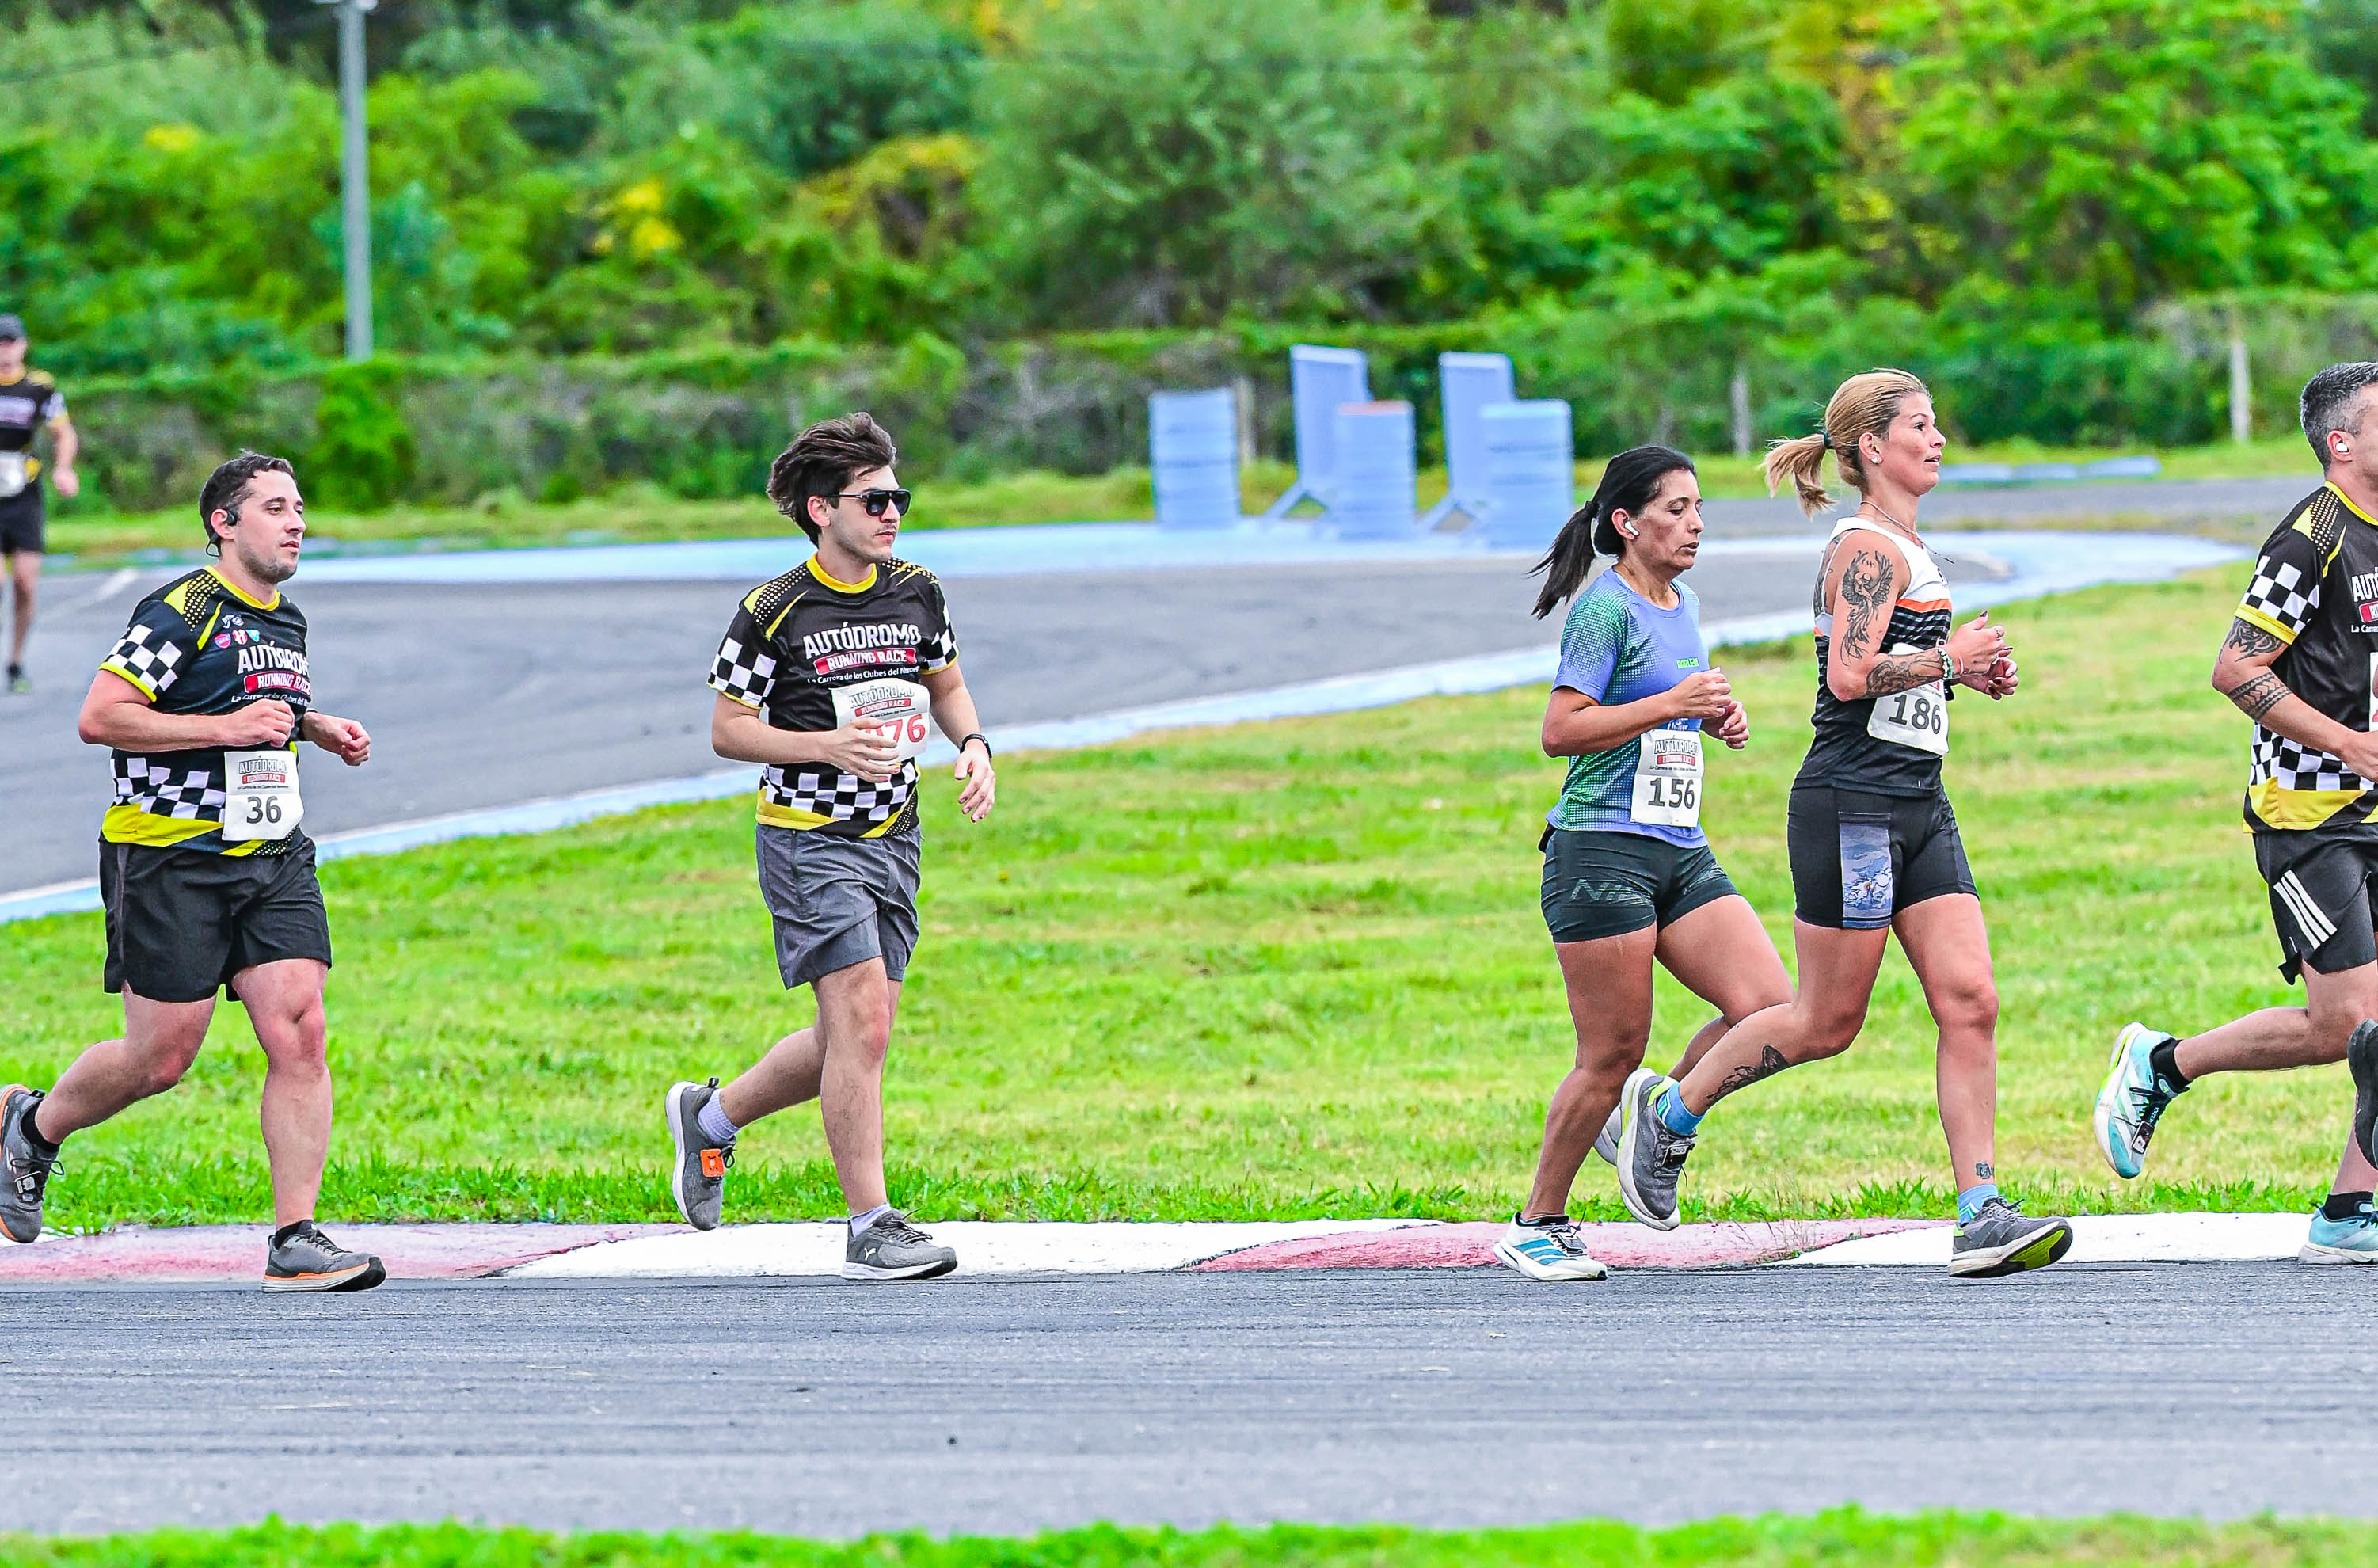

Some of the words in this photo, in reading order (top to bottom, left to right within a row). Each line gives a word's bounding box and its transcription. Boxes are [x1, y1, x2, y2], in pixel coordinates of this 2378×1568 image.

[803, 622, 922, 659] AUTÓDROMO
[2350, 624, 2359, 633] La
[826, 651, 875, 671] RUNNING
[876, 649, 907, 663] RACE
[257, 673, 295, 688] RUNNING
[854, 671, 863, 679] los
[863, 669, 887, 678] Clubes
[888, 667, 899, 676] del
[1888, 694, 1941, 735] 186
[1648, 777, 1695, 809] 156
[246, 796, 282, 824] 36
